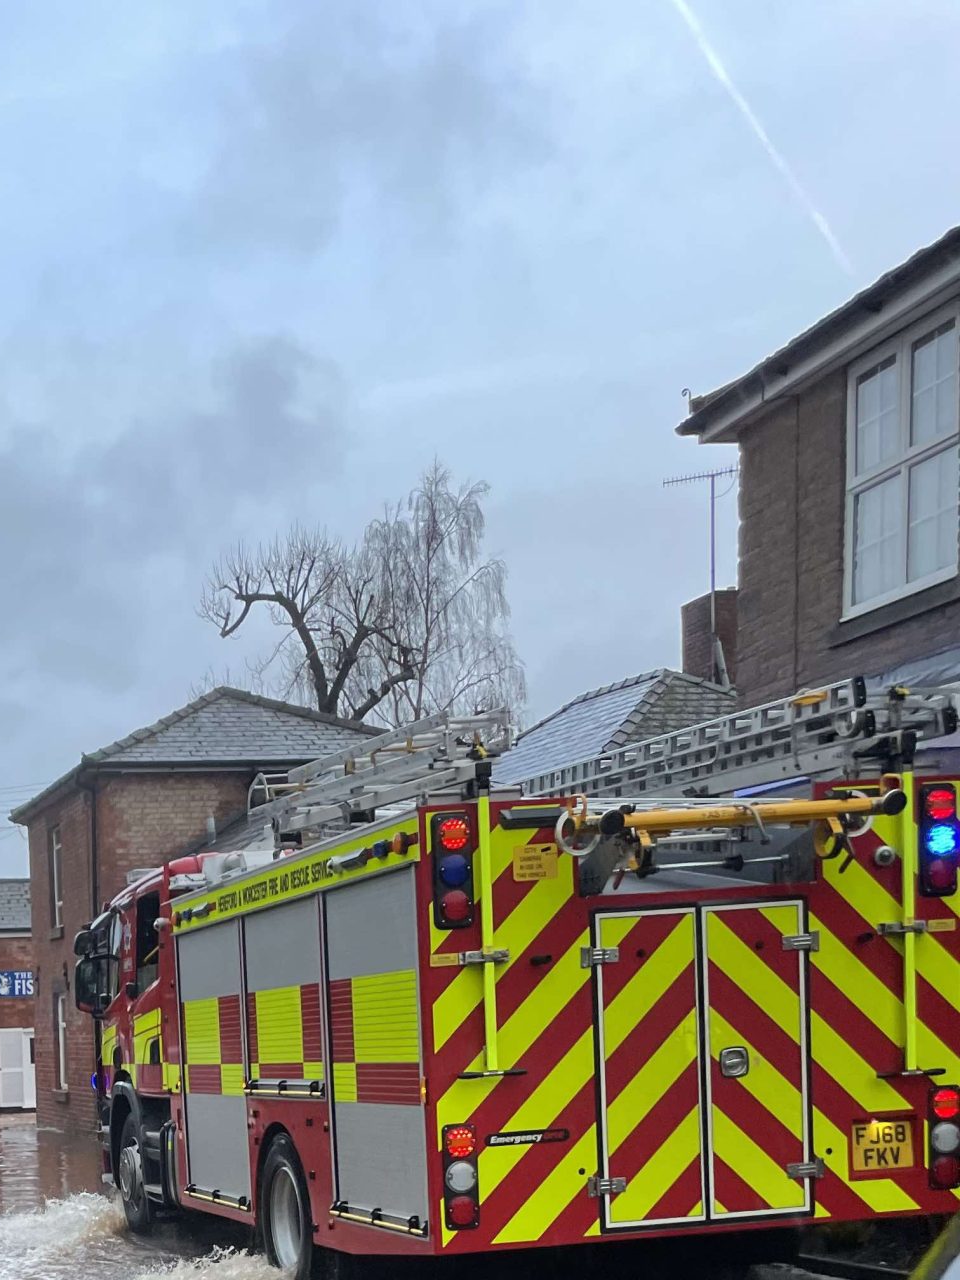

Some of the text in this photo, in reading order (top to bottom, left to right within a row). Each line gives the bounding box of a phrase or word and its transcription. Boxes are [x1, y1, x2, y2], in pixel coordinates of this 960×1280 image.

[290, 865, 310, 889] RESCUE
[14, 971, 33, 979] THE
[489, 1133, 543, 1144] Emergency
[855, 1124, 907, 1146] FJ68
[863, 1146, 901, 1167] FKV
